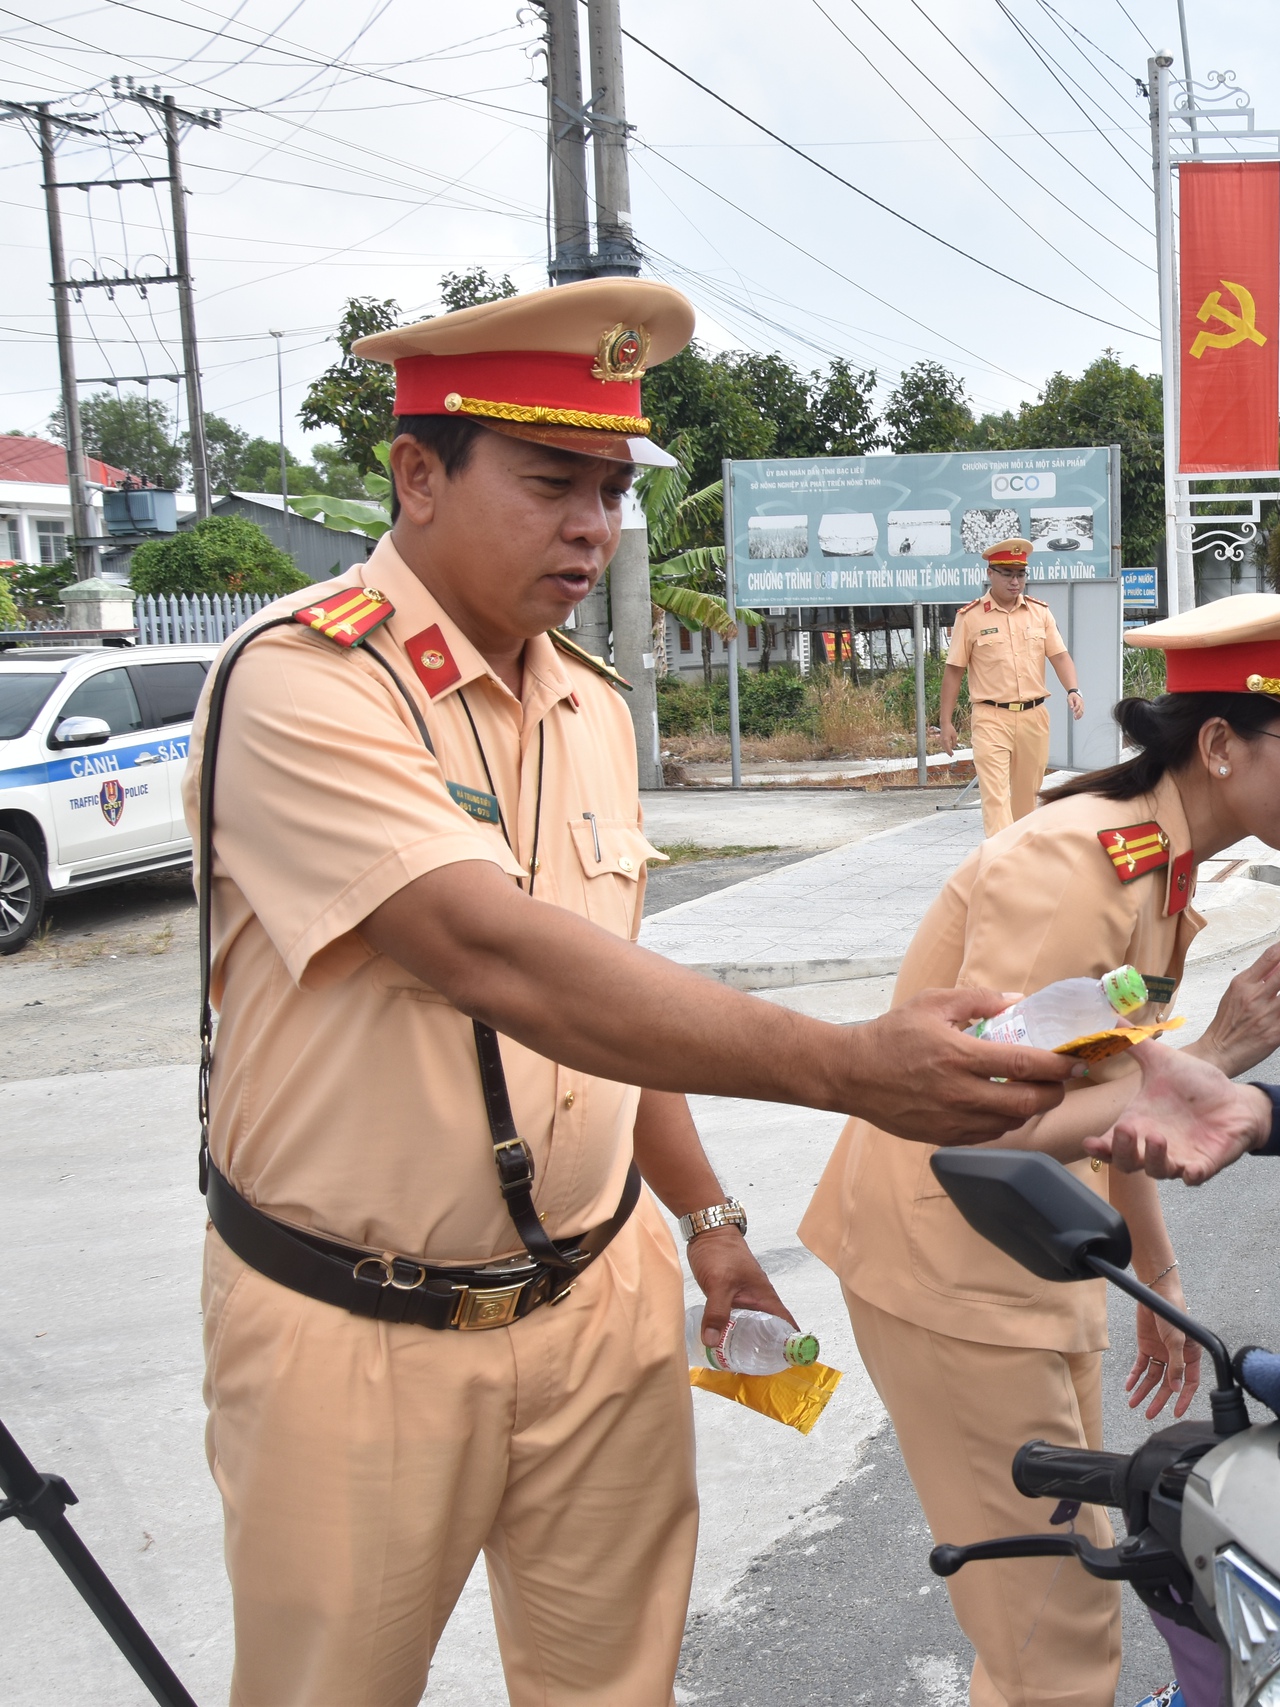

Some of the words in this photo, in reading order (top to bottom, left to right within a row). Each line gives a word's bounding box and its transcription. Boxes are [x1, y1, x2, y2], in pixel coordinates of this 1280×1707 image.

[776, 468, 788, 476] BAN
[790, 467, 806, 476] NHÂN
[962, 462, 988, 471] CHƯƠNG
[990, 461, 1008, 470] TRÌNH
[1026, 460, 1034, 468] XÃ
[1036, 459, 1050, 469] MỘT
[1052, 458, 1064, 467] SẢN
[760, 481, 776, 490] NÔNG
[800, 479, 808, 488] VÀ
[810, 480, 825, 488] PHÁT
[748, 570, 783, 590] CHƯƠNG
[785, 568, 812, 589] TRÌNH
[840, 566, 864, 588] PHÁT
[866, 561, 894, 588] TRIỂN
[896, 570, 918, 586] KINH
[920, 562, 932, 586] TẾ
[935, 564, 960, 586] NÔNG
[1032, 562, 1044, 580] VÀ
[1125, 572, 1137, 584] CẤP
[1138, 573, 1154, 584] NƯỚC
[158, 741, 188, 762] SÁT
[70, 754, 119, 778] CẢNH
[125, 784, 149, 798] POLICE
[69, 794, 100, 810] TRAFFIC
